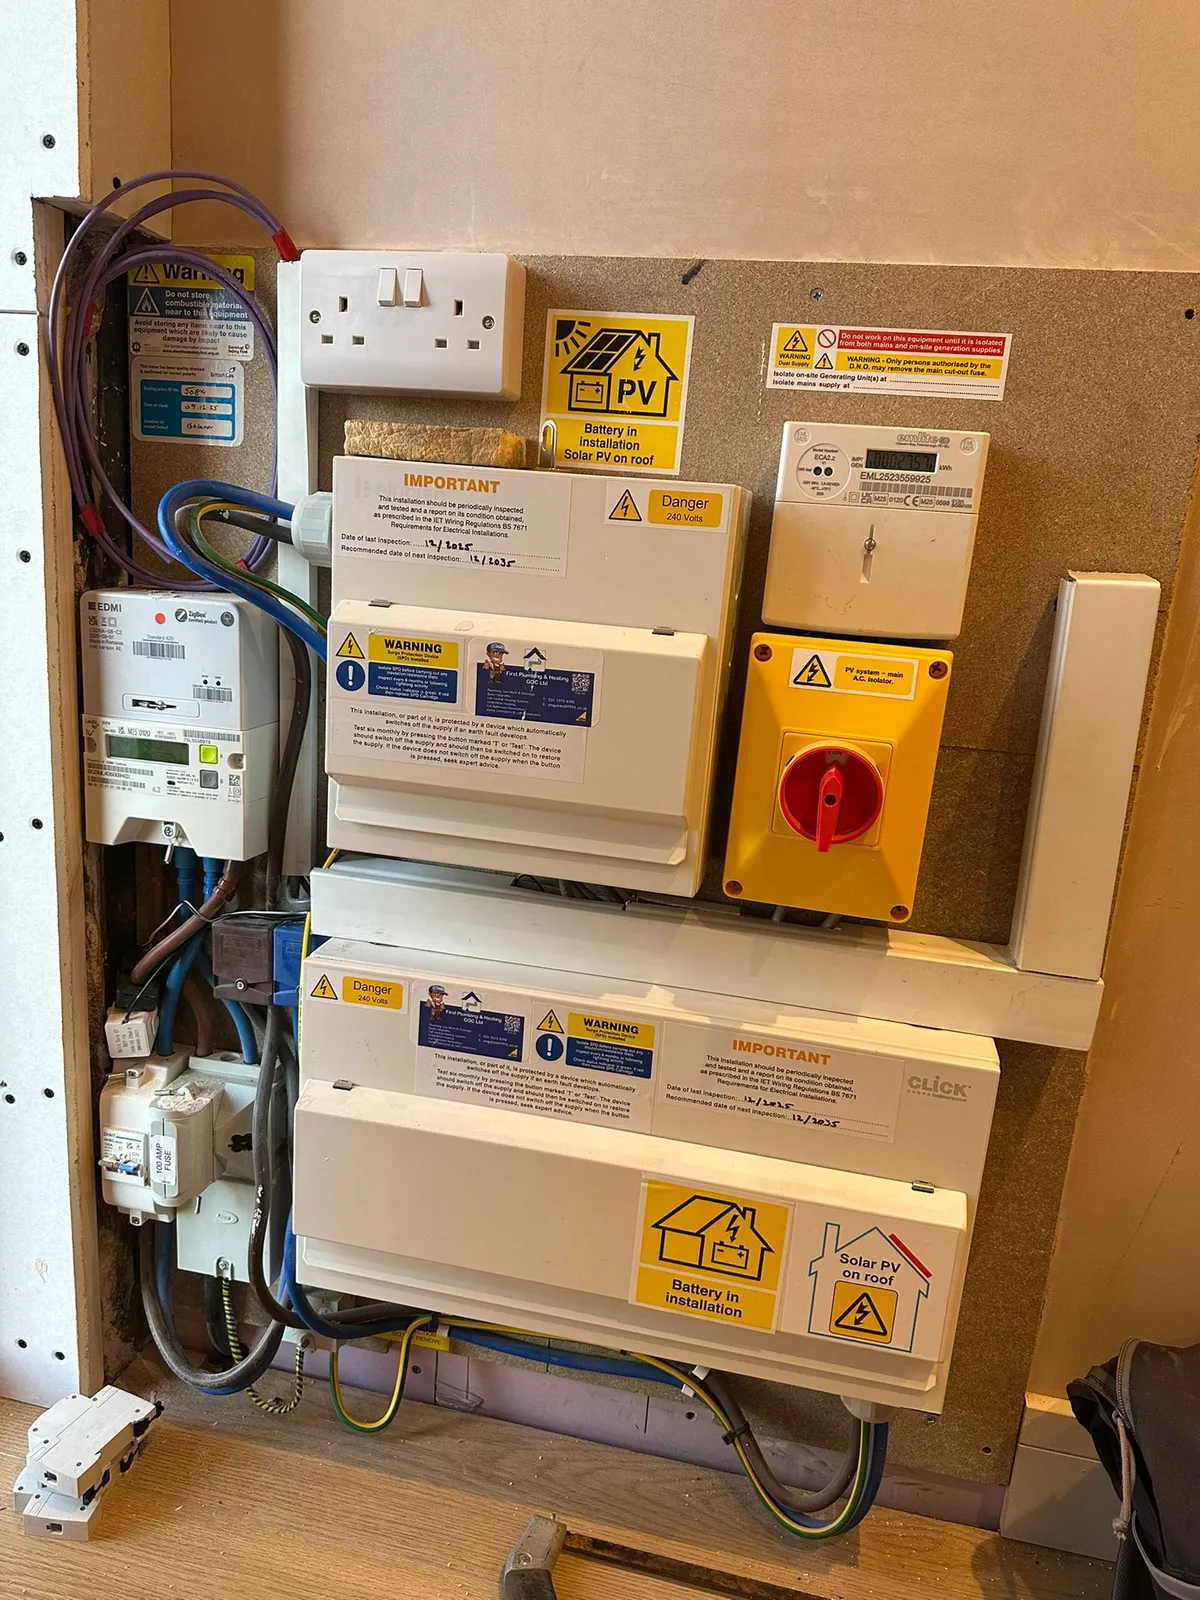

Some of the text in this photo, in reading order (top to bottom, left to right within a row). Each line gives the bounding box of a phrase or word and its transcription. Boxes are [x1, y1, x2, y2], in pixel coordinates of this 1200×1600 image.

[190, 291, 211, 299] store
[885, 357, 902, 365] Only
[969, 361, 978, 369] by
[819, 372, 855, 381] Generating
[856, 374, 879, 382] Unit(s)
[617, 379, 657, 405] PV
[584, 422, 637, 438] Battery in
[579, 436, 639, 450] installation
[564, 448, 654, 465] Solar PV on roof
[404, 473, 500, 493] IMPORTANT
[860, 472, 931, 483] EML2523559925
[378, 494, 392, 502] This
[393, 496, 425, 505] installation
[426, 499, 447, 507] should
[457, 503, 492, 512] periodically
[493, 506, 523, 514] inspected
[662, 494, 709, 510] Danger
[874, 494, 887, 502] M25
[382, 513, 414, 522] prescribed
[444, 517, 464, 527] Wiring
[465, 519, 501, 529] Regulations
[502, 522, 511, 530] BS
[513, 523, 527, 531] 7671
[495, 514, 524, 523] obtained,
[666, 512, 703, 522] 240 Volts
[390, 521, 432, 531] Requirements
[442, 525, 470, 534] Electrical
[471, 528, 508, 538] Installations.
[377, 537, 410, 545] inspection:
[425, 538, 473, 552] 12/2025
[341, 544, 387, 555] Recommended
[426, 553, 461, 562] inspection:
[469, 554, 516, 568] 12/2035
[97, 602, 121, 612] EDMI
[384, 638, 441, 653] WARNING
[867, 676, 893, 684] isolator.
[353, 980, 392, 995] Danger
[358, 994, 388, 1004] 240 Volts
[583, 1017, 638, 1034] WARNING
[732, 1039, 830, 1065] IMPORTANT
[666, 1083, 681, 1091] Date
[702, 1090, 737, 1100] inspection:
[665, 1093, 712, 1106] Recommended
[751, 1108, 785, 1118] inspection:
[839, 1253, 901, 1273] Solar PV
[842, 1269, 894, 1286] on roof
[672, 1278, 738, 1303] Battery in
[665, 1291, 741, 1318] installation
